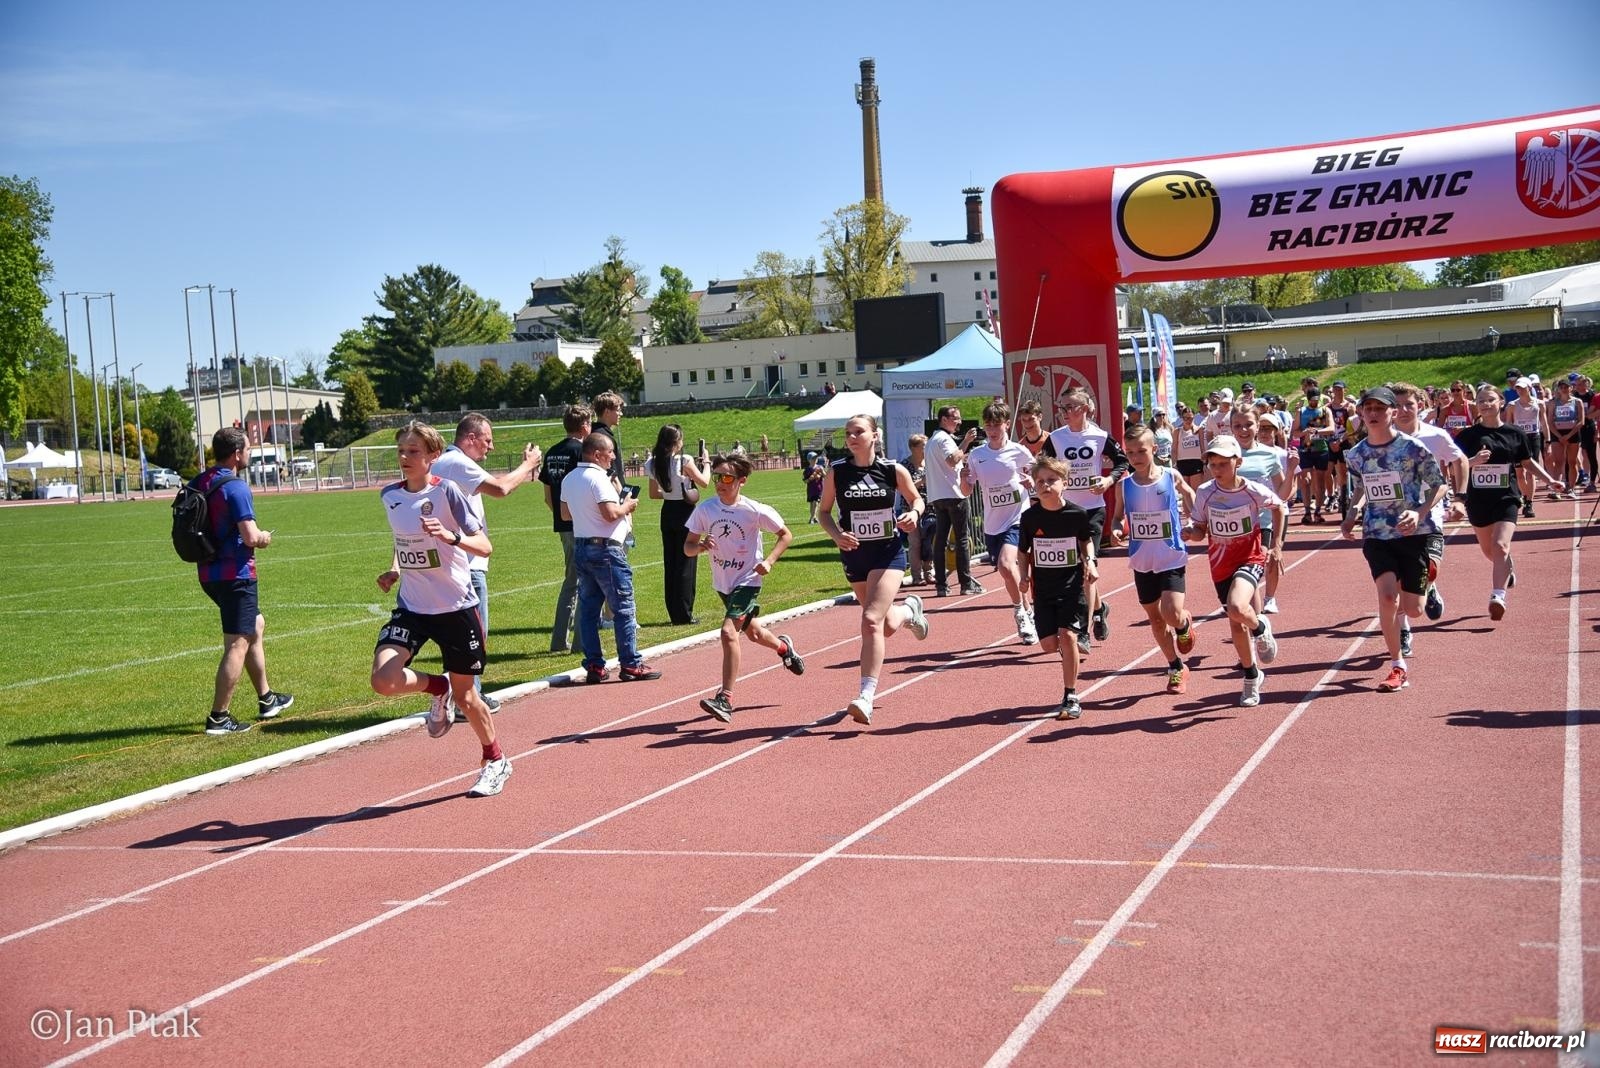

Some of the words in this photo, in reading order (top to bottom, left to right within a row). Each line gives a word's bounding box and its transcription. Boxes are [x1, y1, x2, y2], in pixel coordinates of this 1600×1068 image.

[1311, 146, 1404, 174] BIEG
[1165, 179, 1218, 200] SIR
[1248, 187, 1323, 218] BEZ
[1328, 170, 1474, 210] GRANIC
[1267, 211, 1455, 251] RACIBÓRZ
[892, 380, 943, 391] PersonalBest
[1064, 447, 1093, 460] GO
[1067, 477, 1088, 487] 002
[1477, 474, 1497, 484] 001
[844, 488, 887, 498] adidas
[1371, 485, 1391, 497] 015
[992, 493, 1012, 504] 007
[858, 523, 881, 535] 016
[1137, 523, 1159, 535] 012
[1215, 521, 1239, 533] 010
[399, 550, 427, 565] 005
[1039, 550, 1066, 562] 008
